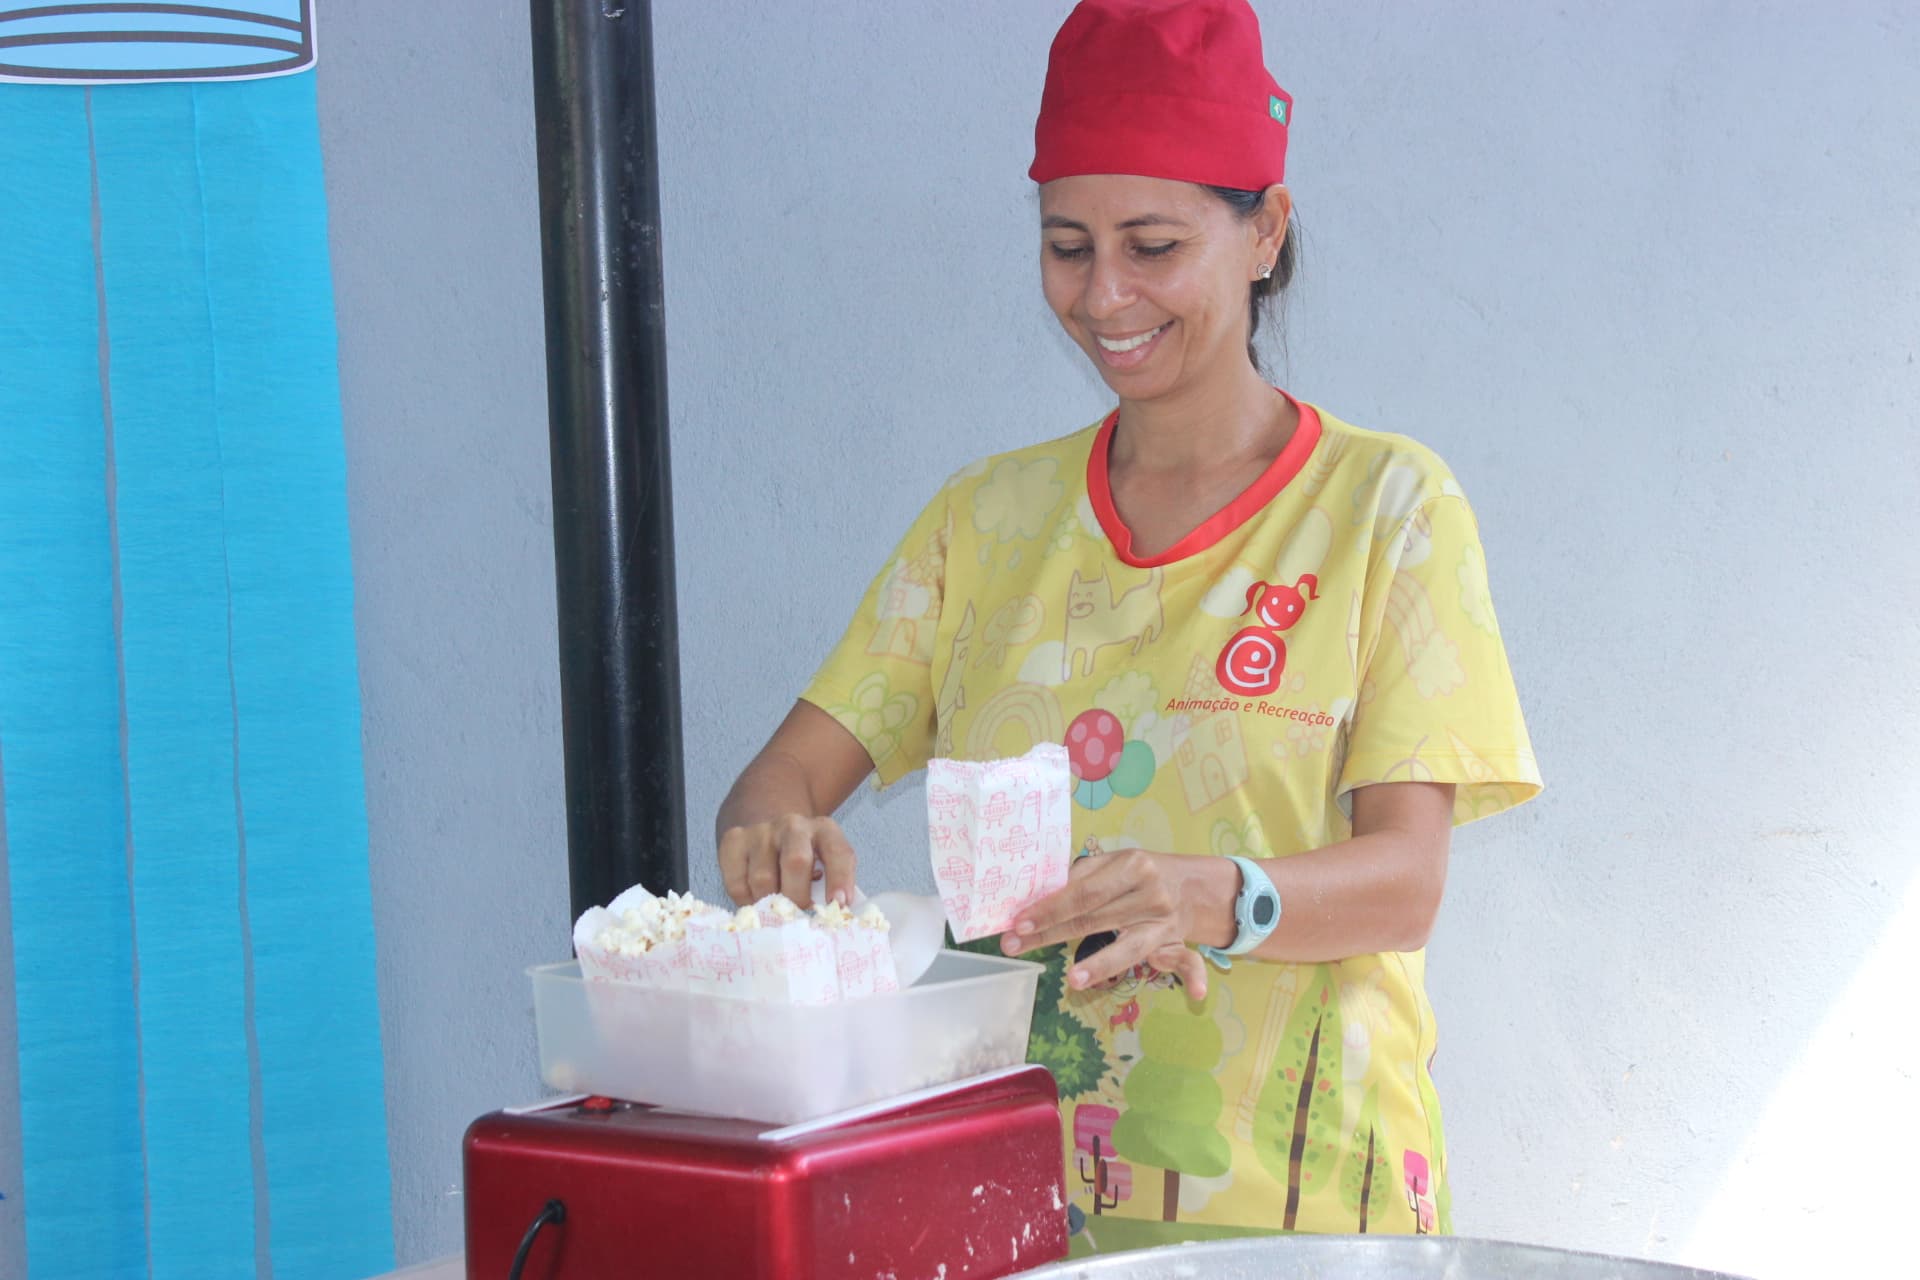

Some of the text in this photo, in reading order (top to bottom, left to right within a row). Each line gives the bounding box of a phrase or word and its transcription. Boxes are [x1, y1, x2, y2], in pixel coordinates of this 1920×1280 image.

[1165, 697, 1335, 727] Animação e Recreação
